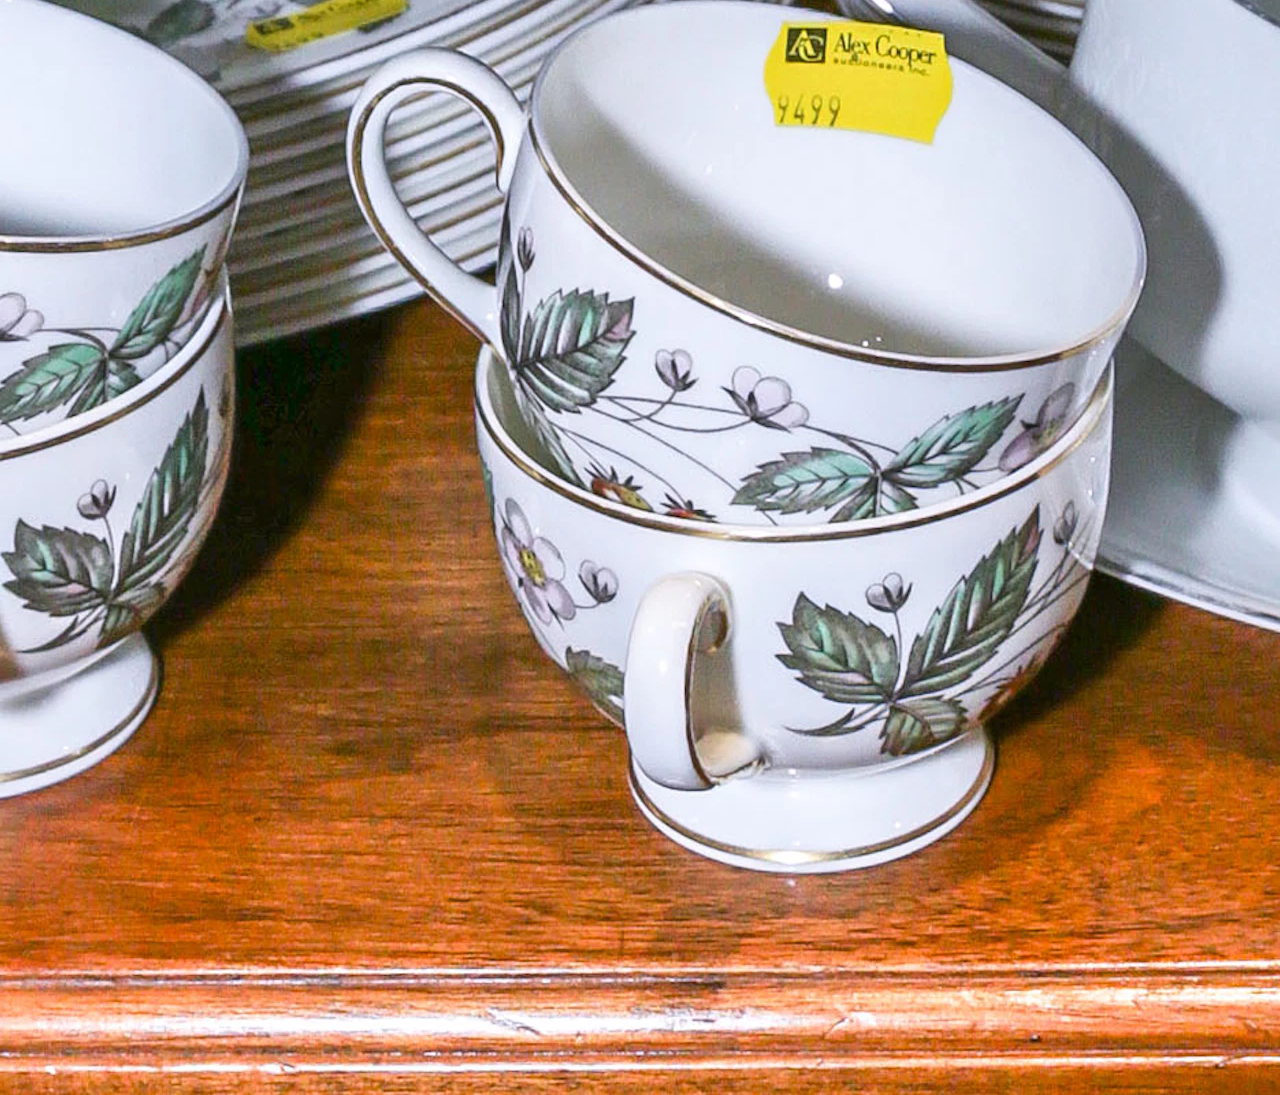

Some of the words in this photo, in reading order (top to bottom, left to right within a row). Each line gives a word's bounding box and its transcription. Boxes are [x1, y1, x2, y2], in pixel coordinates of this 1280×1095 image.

[834, 33, 871, 55] Alex
[875, 34, 937, 68] Cooper
[777, 94, 842, 127] 9499
